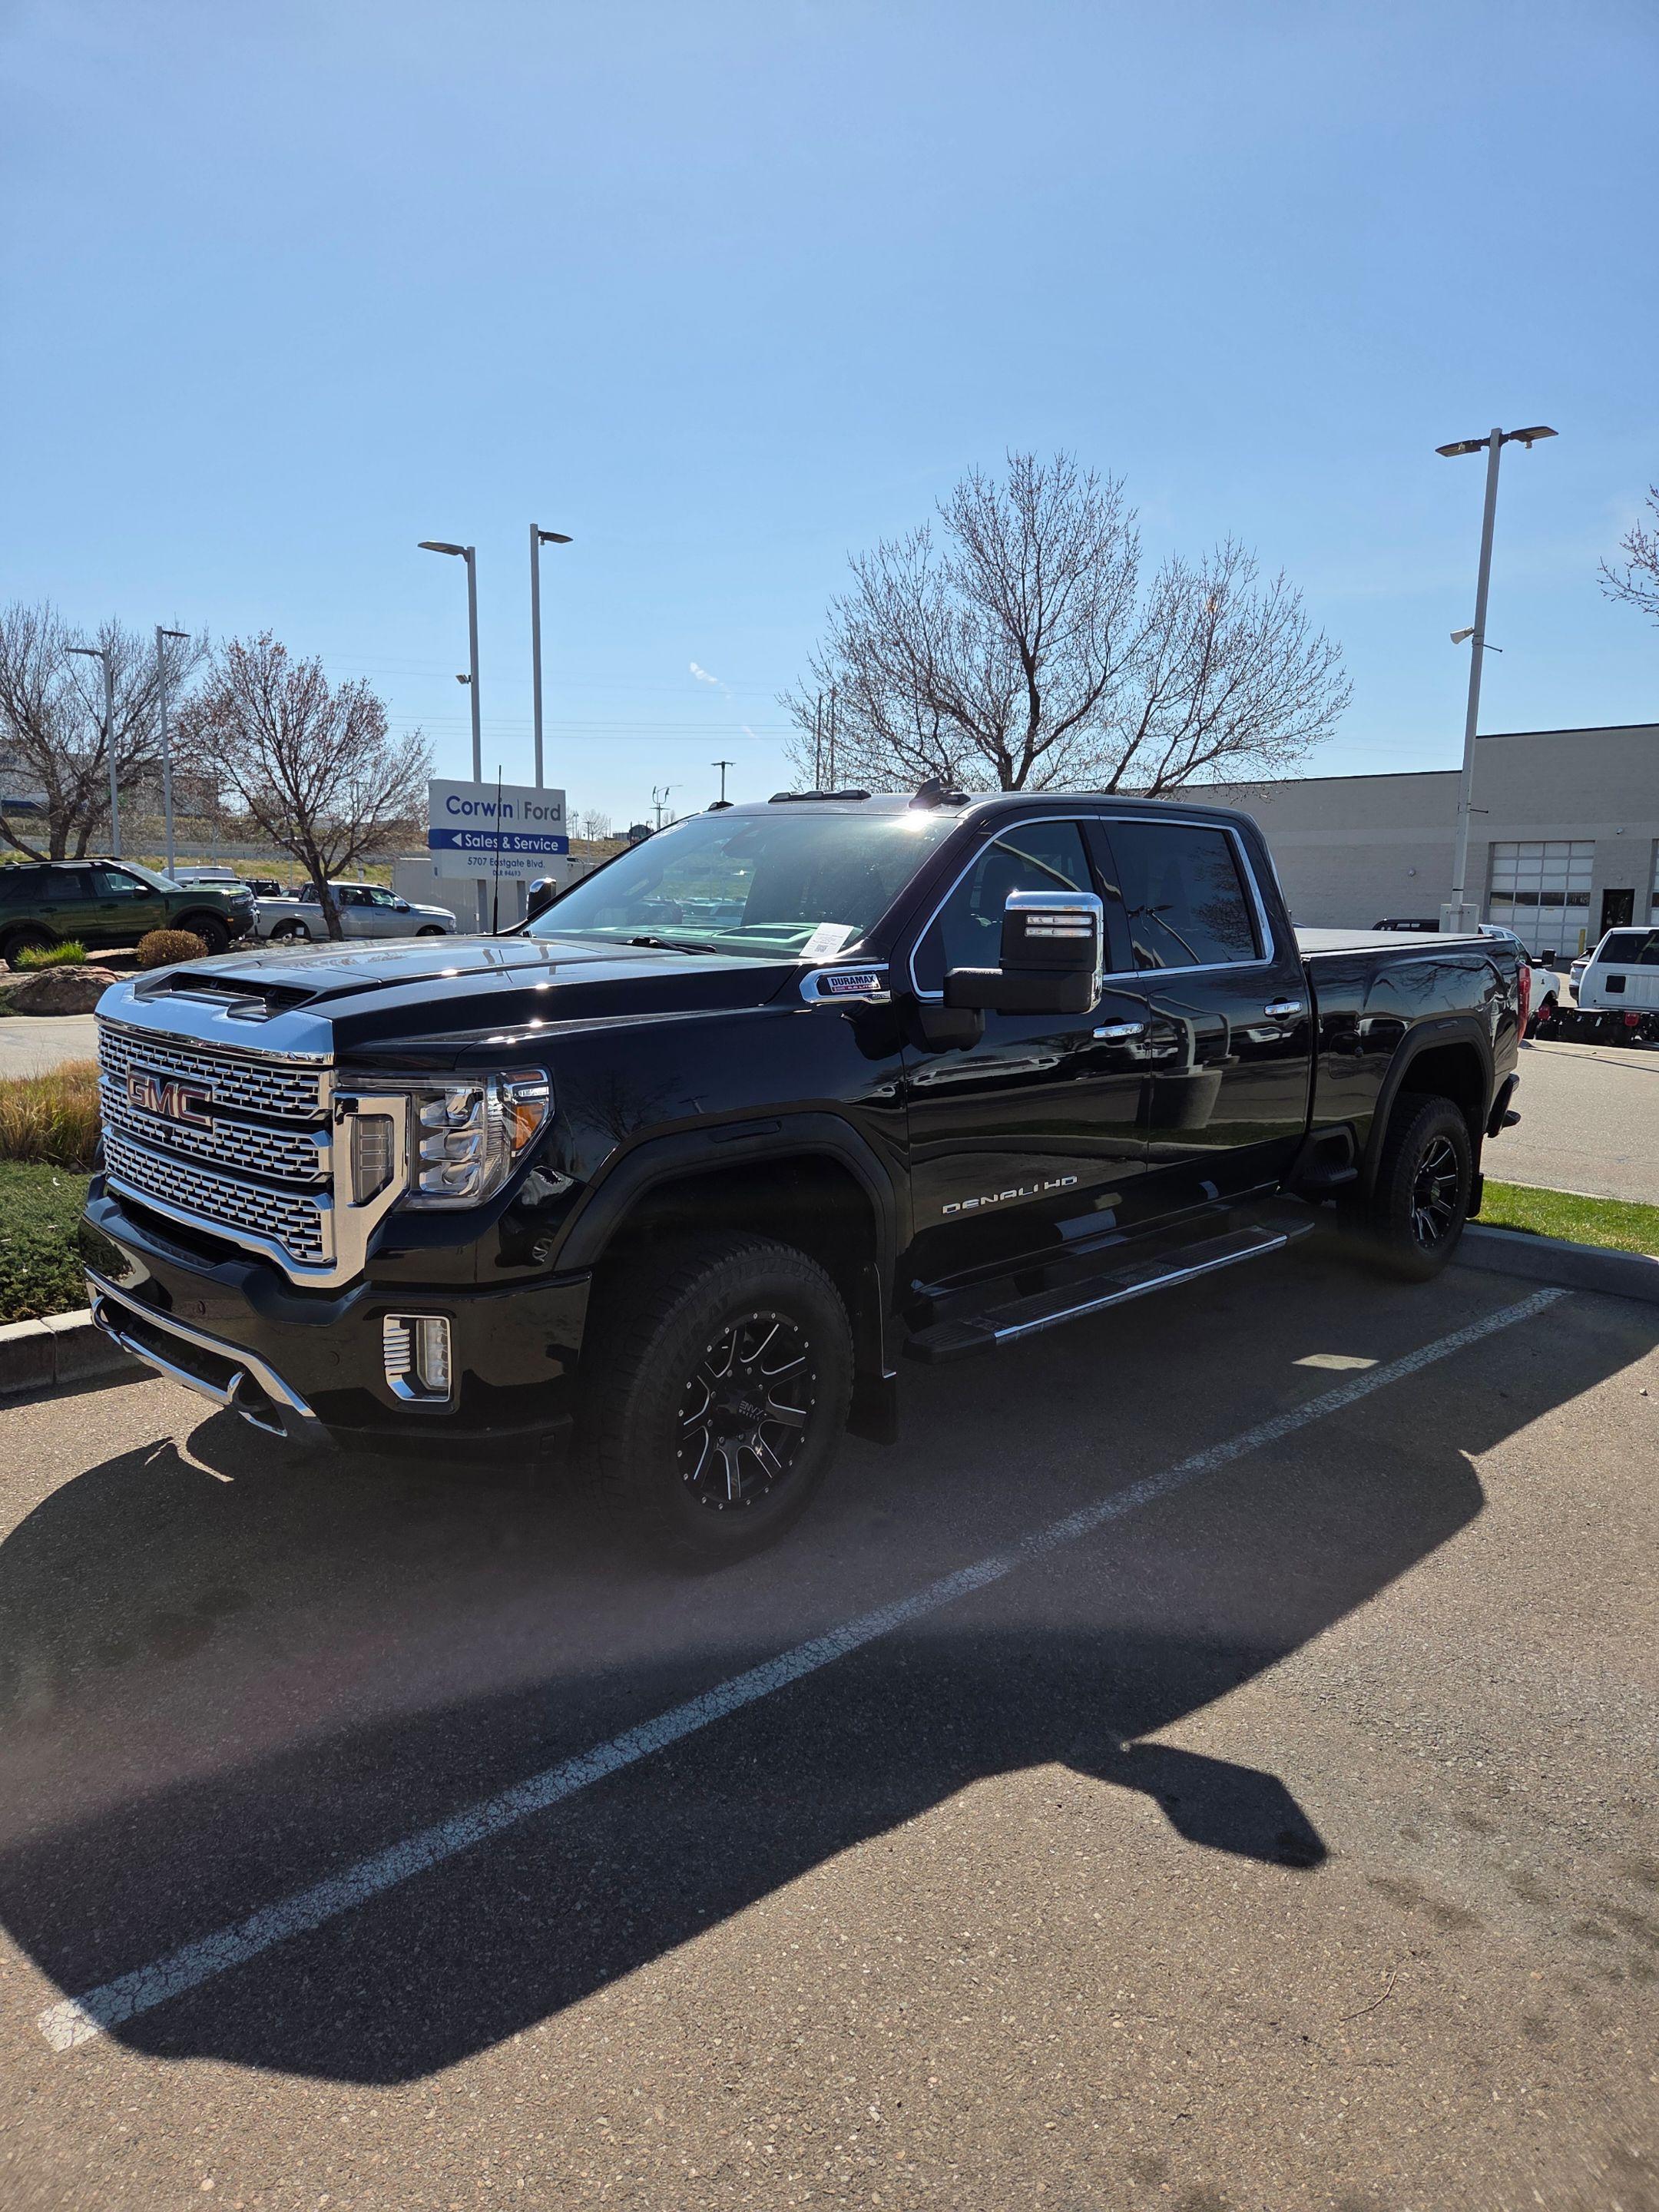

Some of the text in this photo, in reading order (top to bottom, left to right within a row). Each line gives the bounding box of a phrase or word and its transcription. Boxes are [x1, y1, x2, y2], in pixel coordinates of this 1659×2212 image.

[446, 795, 561, 821] Corwin Ford
[465, 833, 558, 851] Sales & Service
[467, 856, 546, 869] 5707 Eastgate Blvd.
[831, 975, 875, 986] DURAMAX
[127, 1074, 213, 1127] GMC
[942, 1175, 1078, 1214] DENALI HD
